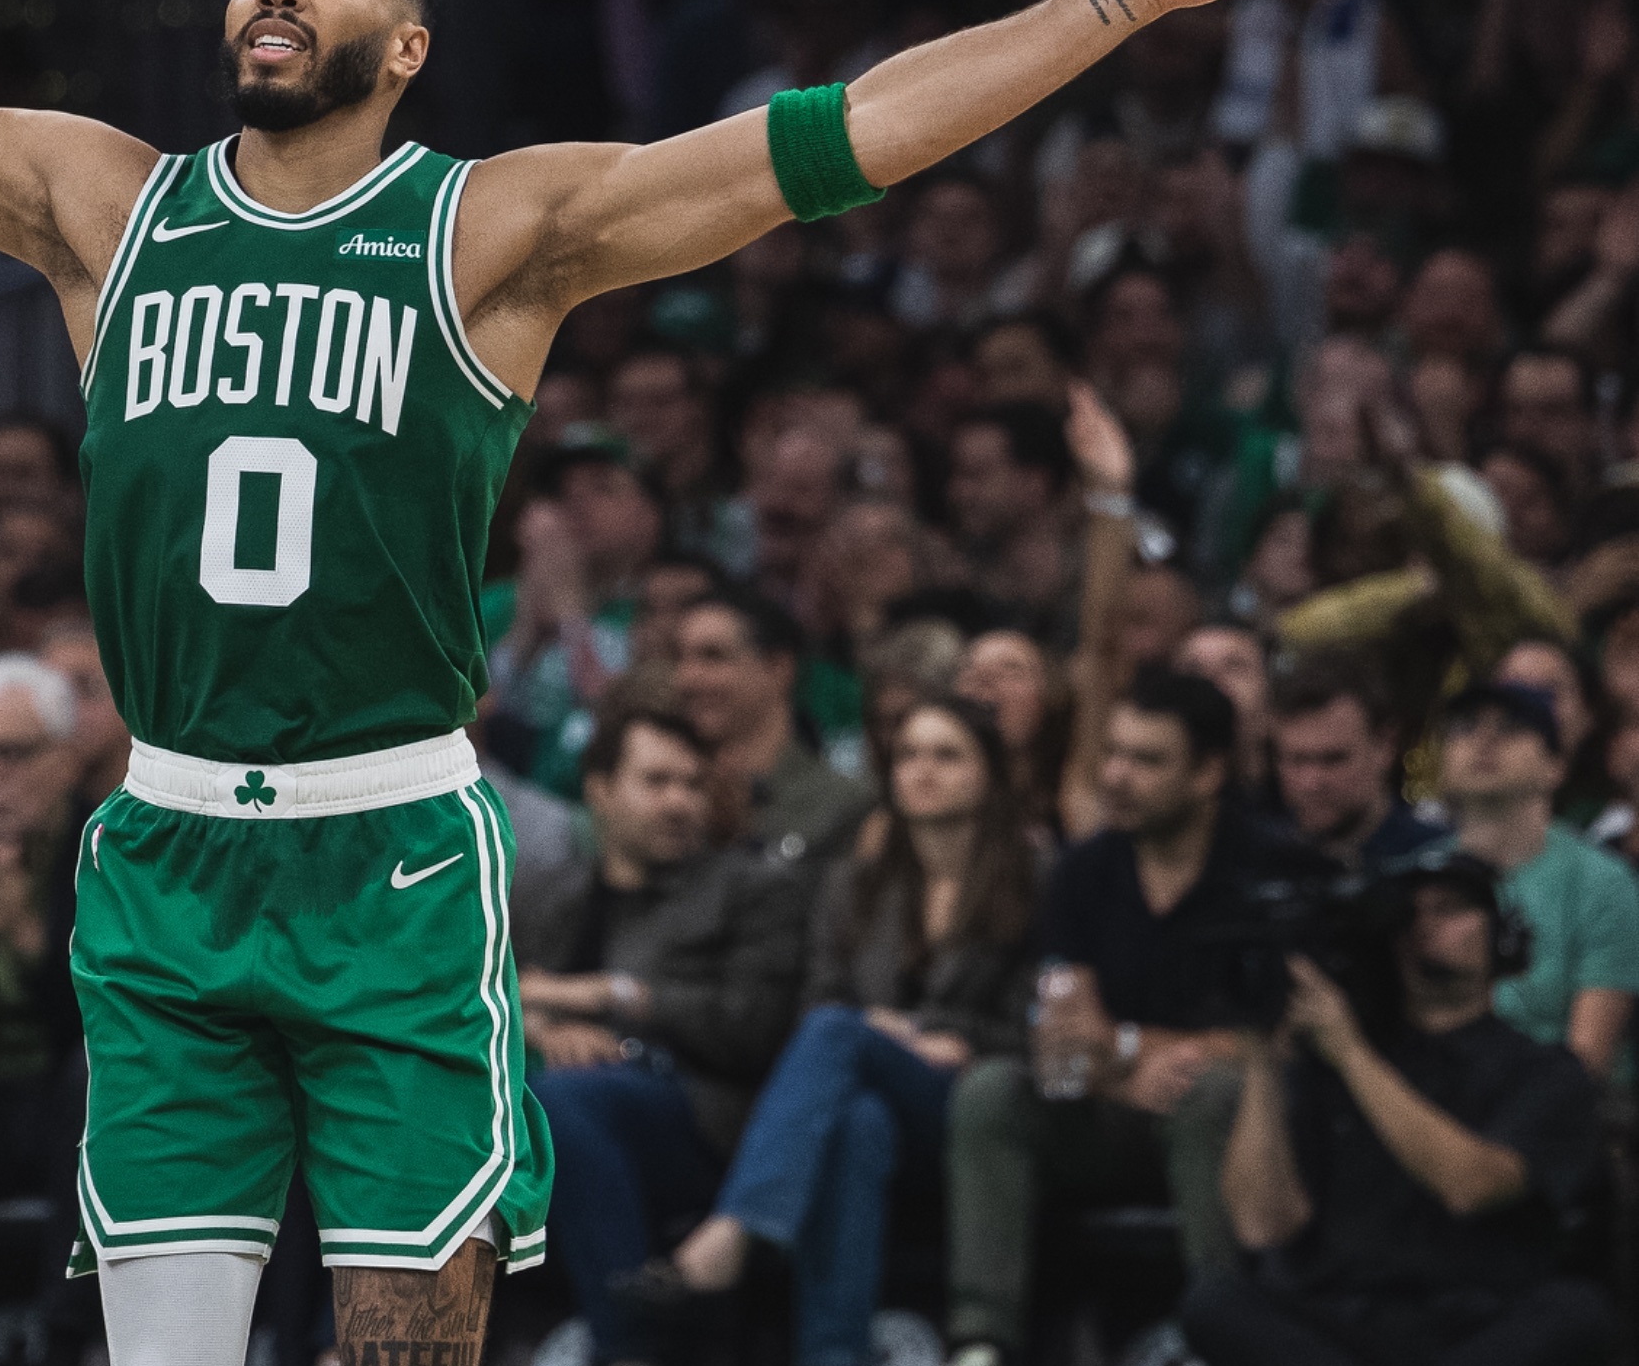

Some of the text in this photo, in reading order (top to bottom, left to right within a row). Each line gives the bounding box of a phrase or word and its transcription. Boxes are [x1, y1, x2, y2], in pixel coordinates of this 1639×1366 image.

[338, 233, 421, 259] Amica
[124, 281, 418, 437] BOSTON
[199, 435, 318, 607] 0
